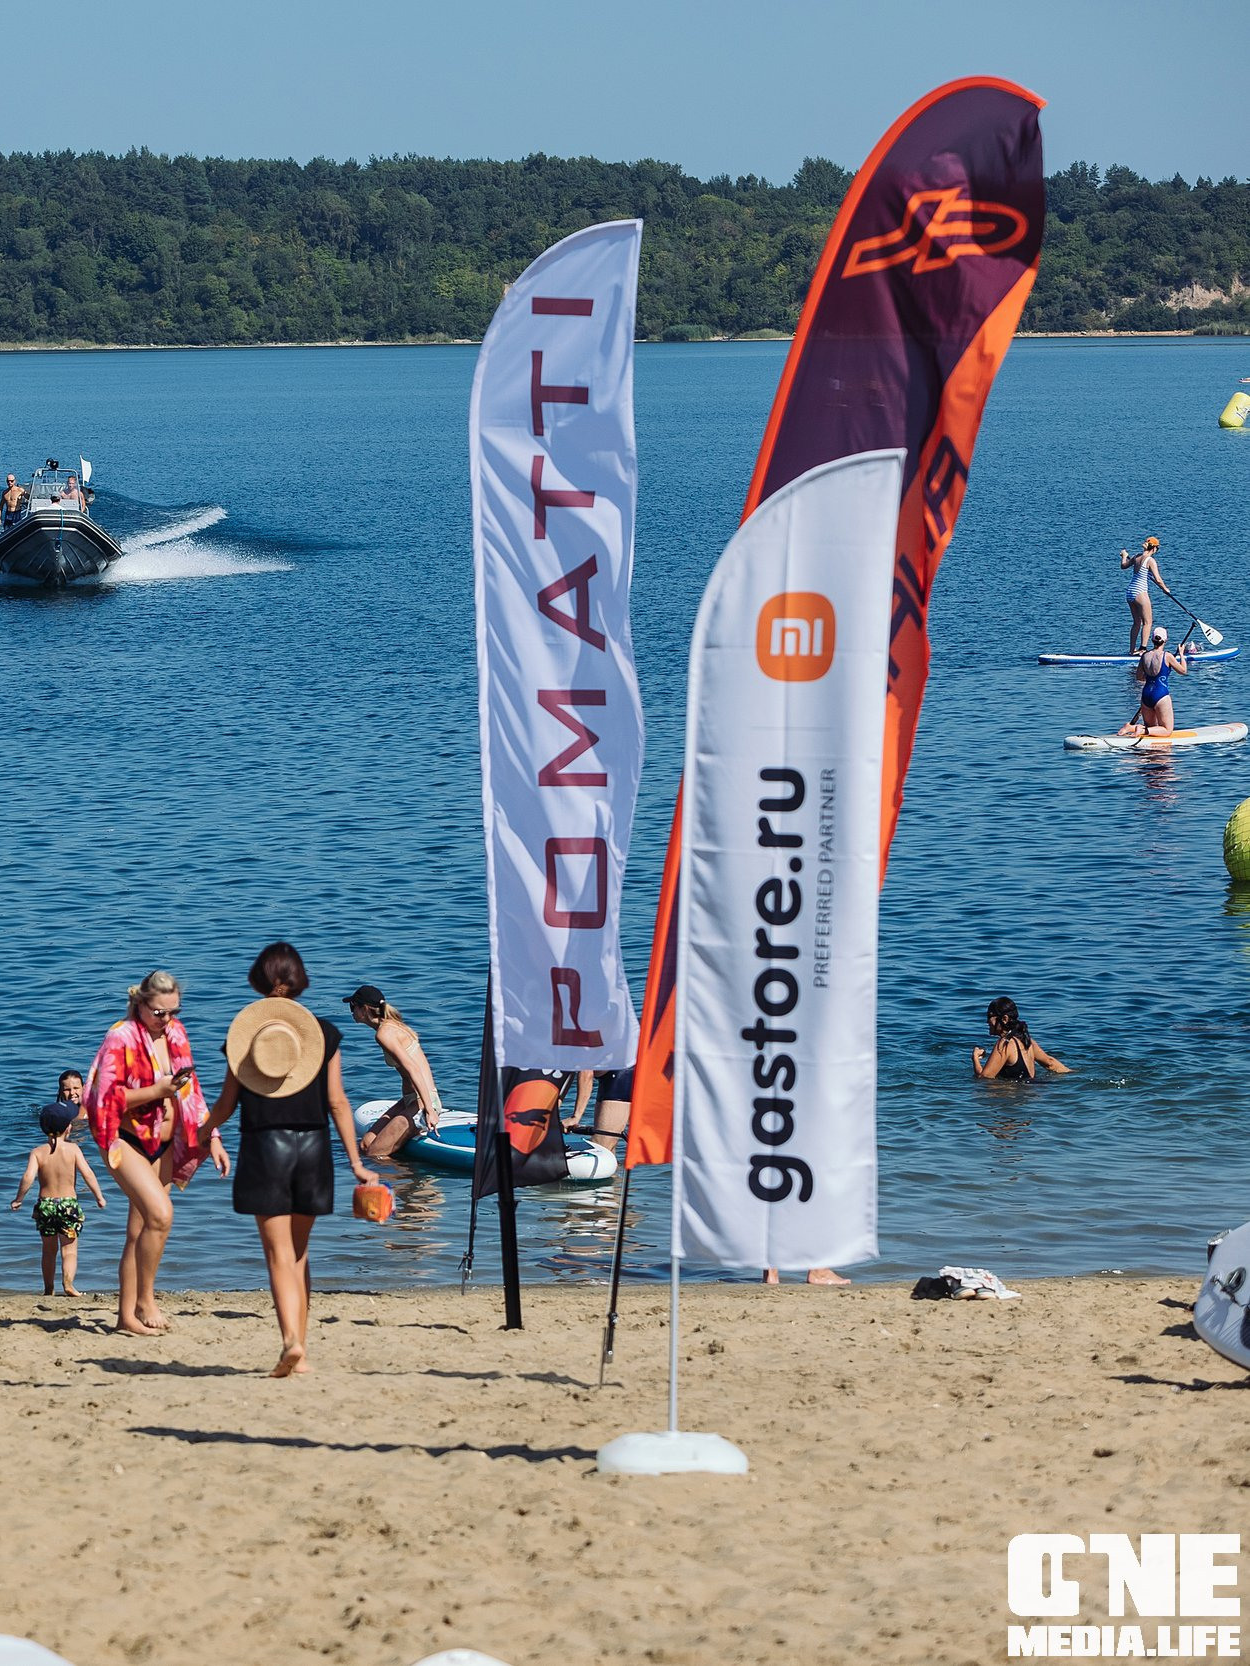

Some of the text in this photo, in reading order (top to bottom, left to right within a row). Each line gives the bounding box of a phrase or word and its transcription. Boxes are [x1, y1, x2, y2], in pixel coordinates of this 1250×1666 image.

[532, 298, 607, 1047] POMATTI
[813, 768, 836, 988] PREFERRED PARTNER
[742, 769, 813, 1202] gastore.ru
